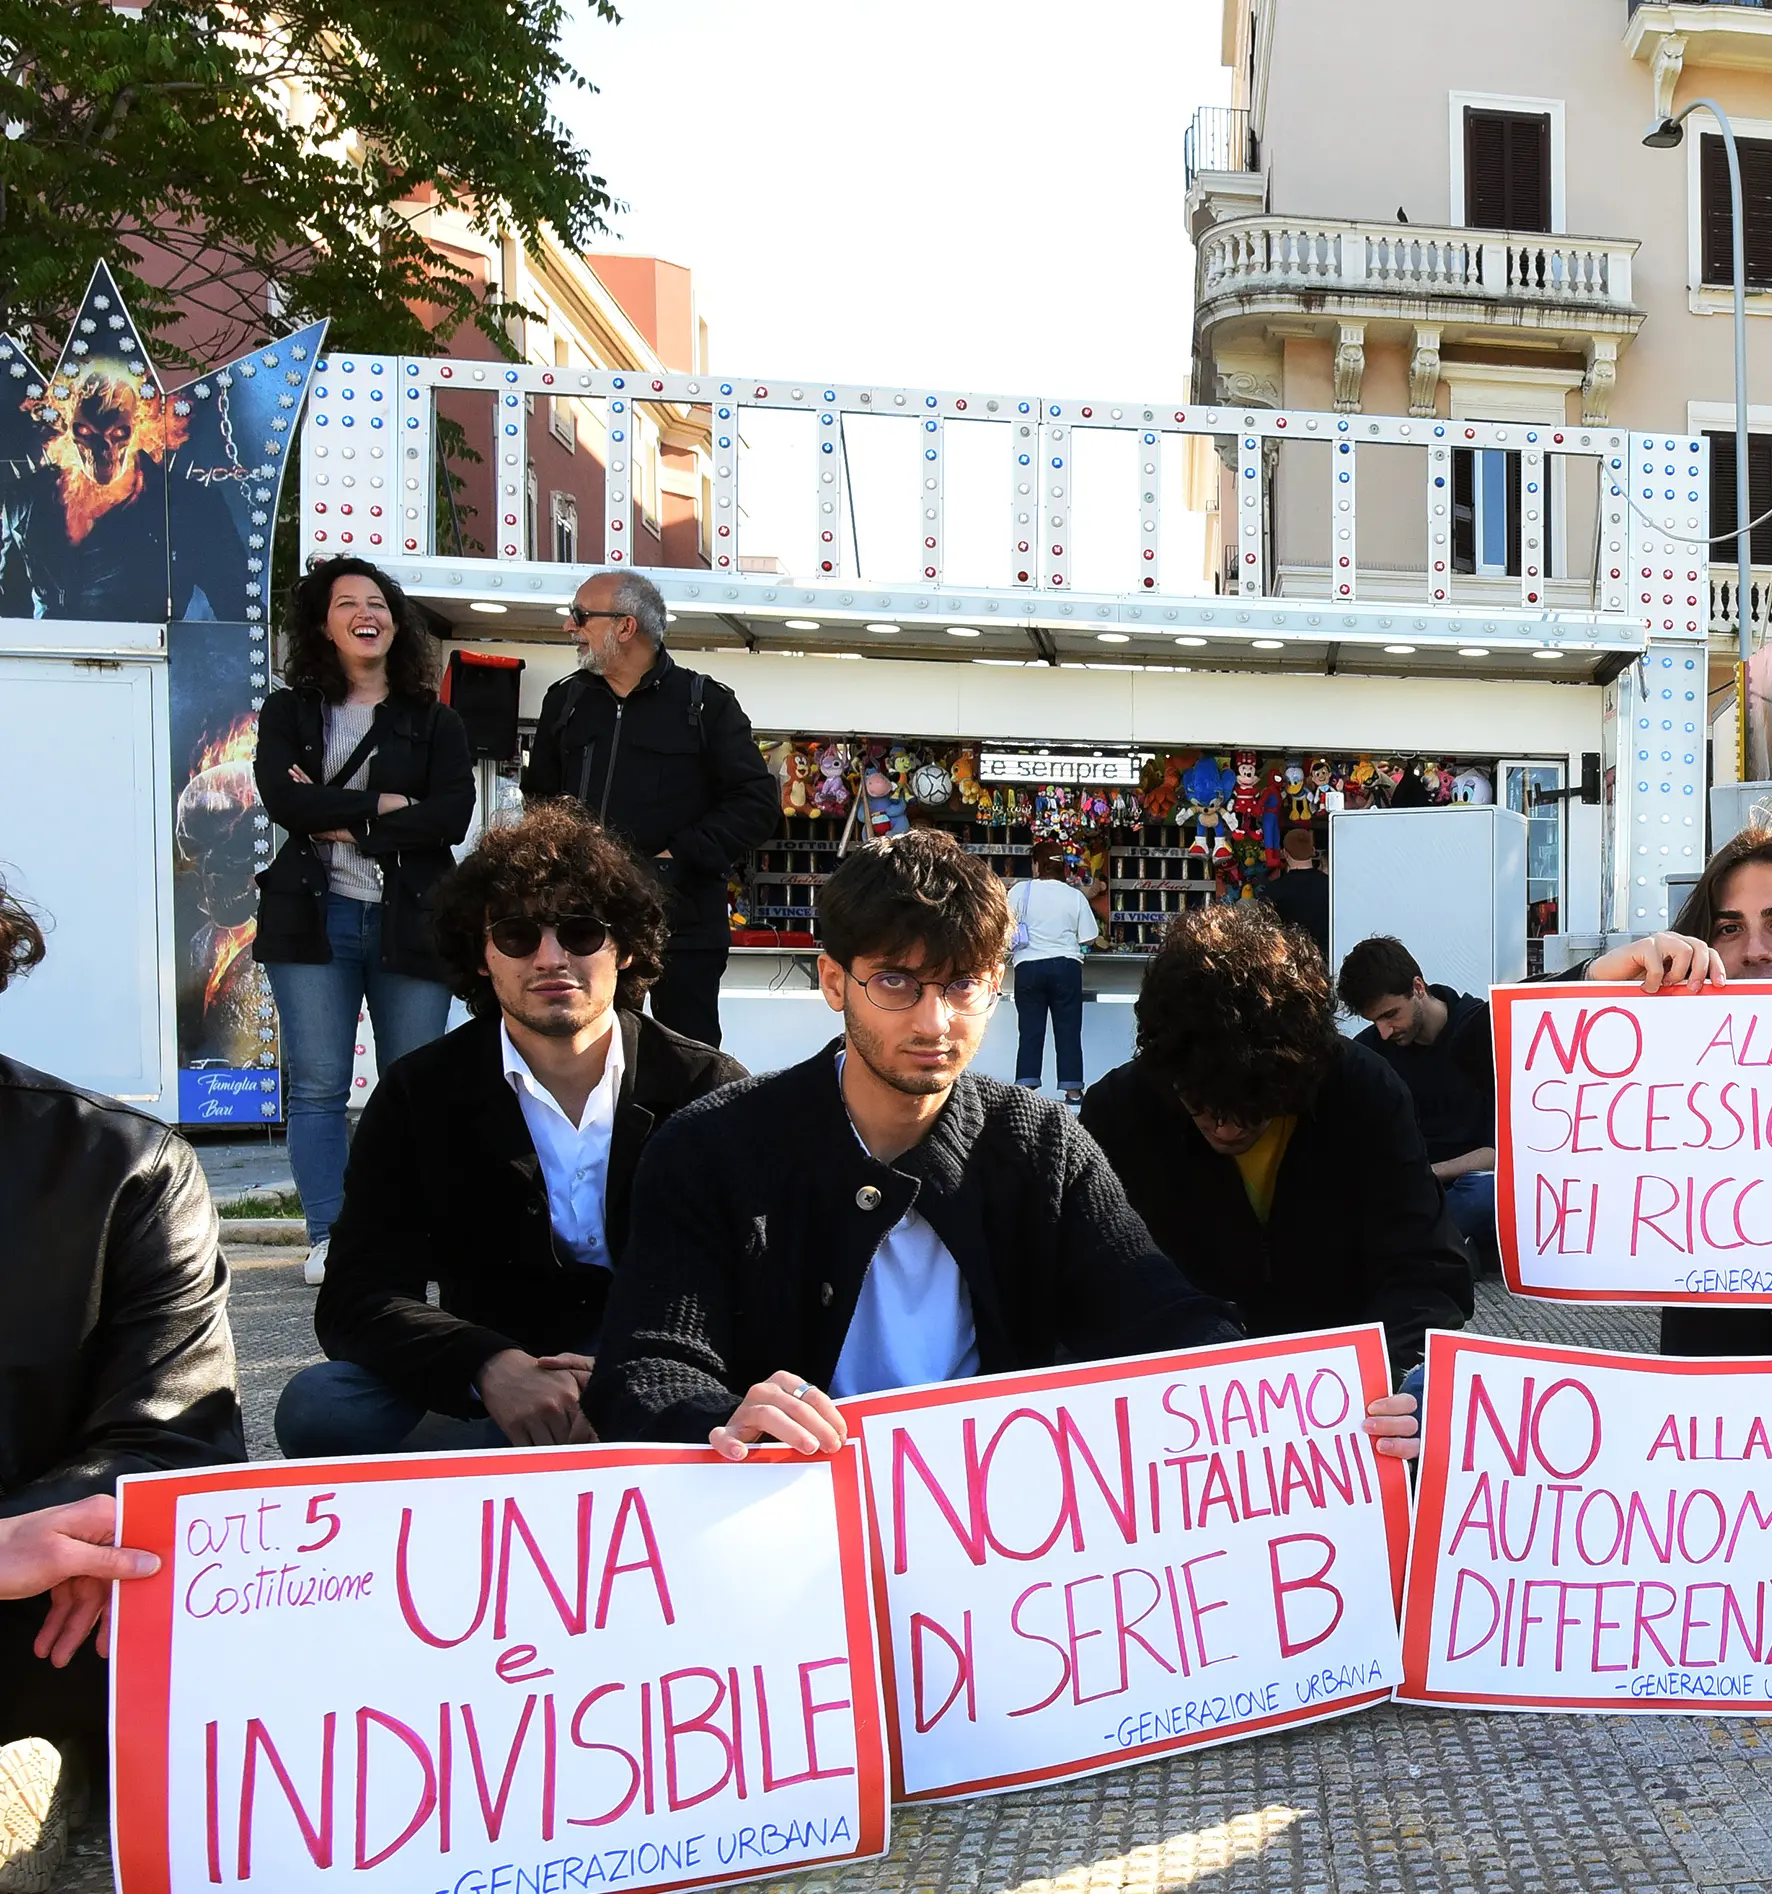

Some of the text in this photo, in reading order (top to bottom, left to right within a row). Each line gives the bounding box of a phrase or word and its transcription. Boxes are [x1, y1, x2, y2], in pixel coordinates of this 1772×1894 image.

[1018, 760, 1118, 783] sempre
[756, 907, 770, 917] SI
[773, 907, 812, 918] VINCE
[1113, 912, 1166, 922] SI VINCE
[1524, 1005, 1643, 1079] NO
[197, 1073, 258, 1095] Famiglia
[197, 1099, 234, 1118] Bari
[1535, 1173, 1599, 1256] DEI
[1462, 1374, 1772, 1480] NO ALLA
[893, 1368, 1350, 1575] NON SIAMO
[1148, 1432, 1373, 1534] ITALIANI
[185, 1492, 341, 1556] art. 5
[184, 1562, 373, 1618] Costituzione
[397, 1486, 676, 1650] UNA
[910, 1532, 1344, 1734] DI SERIE B
[495, 1644, 555, 1684] e
[1295, 1659, 1383, 1705] URBANA
[205, 1656, 857, 1885] INDIVISIBILE
[717, 1815, 851, 1865] URBANA
